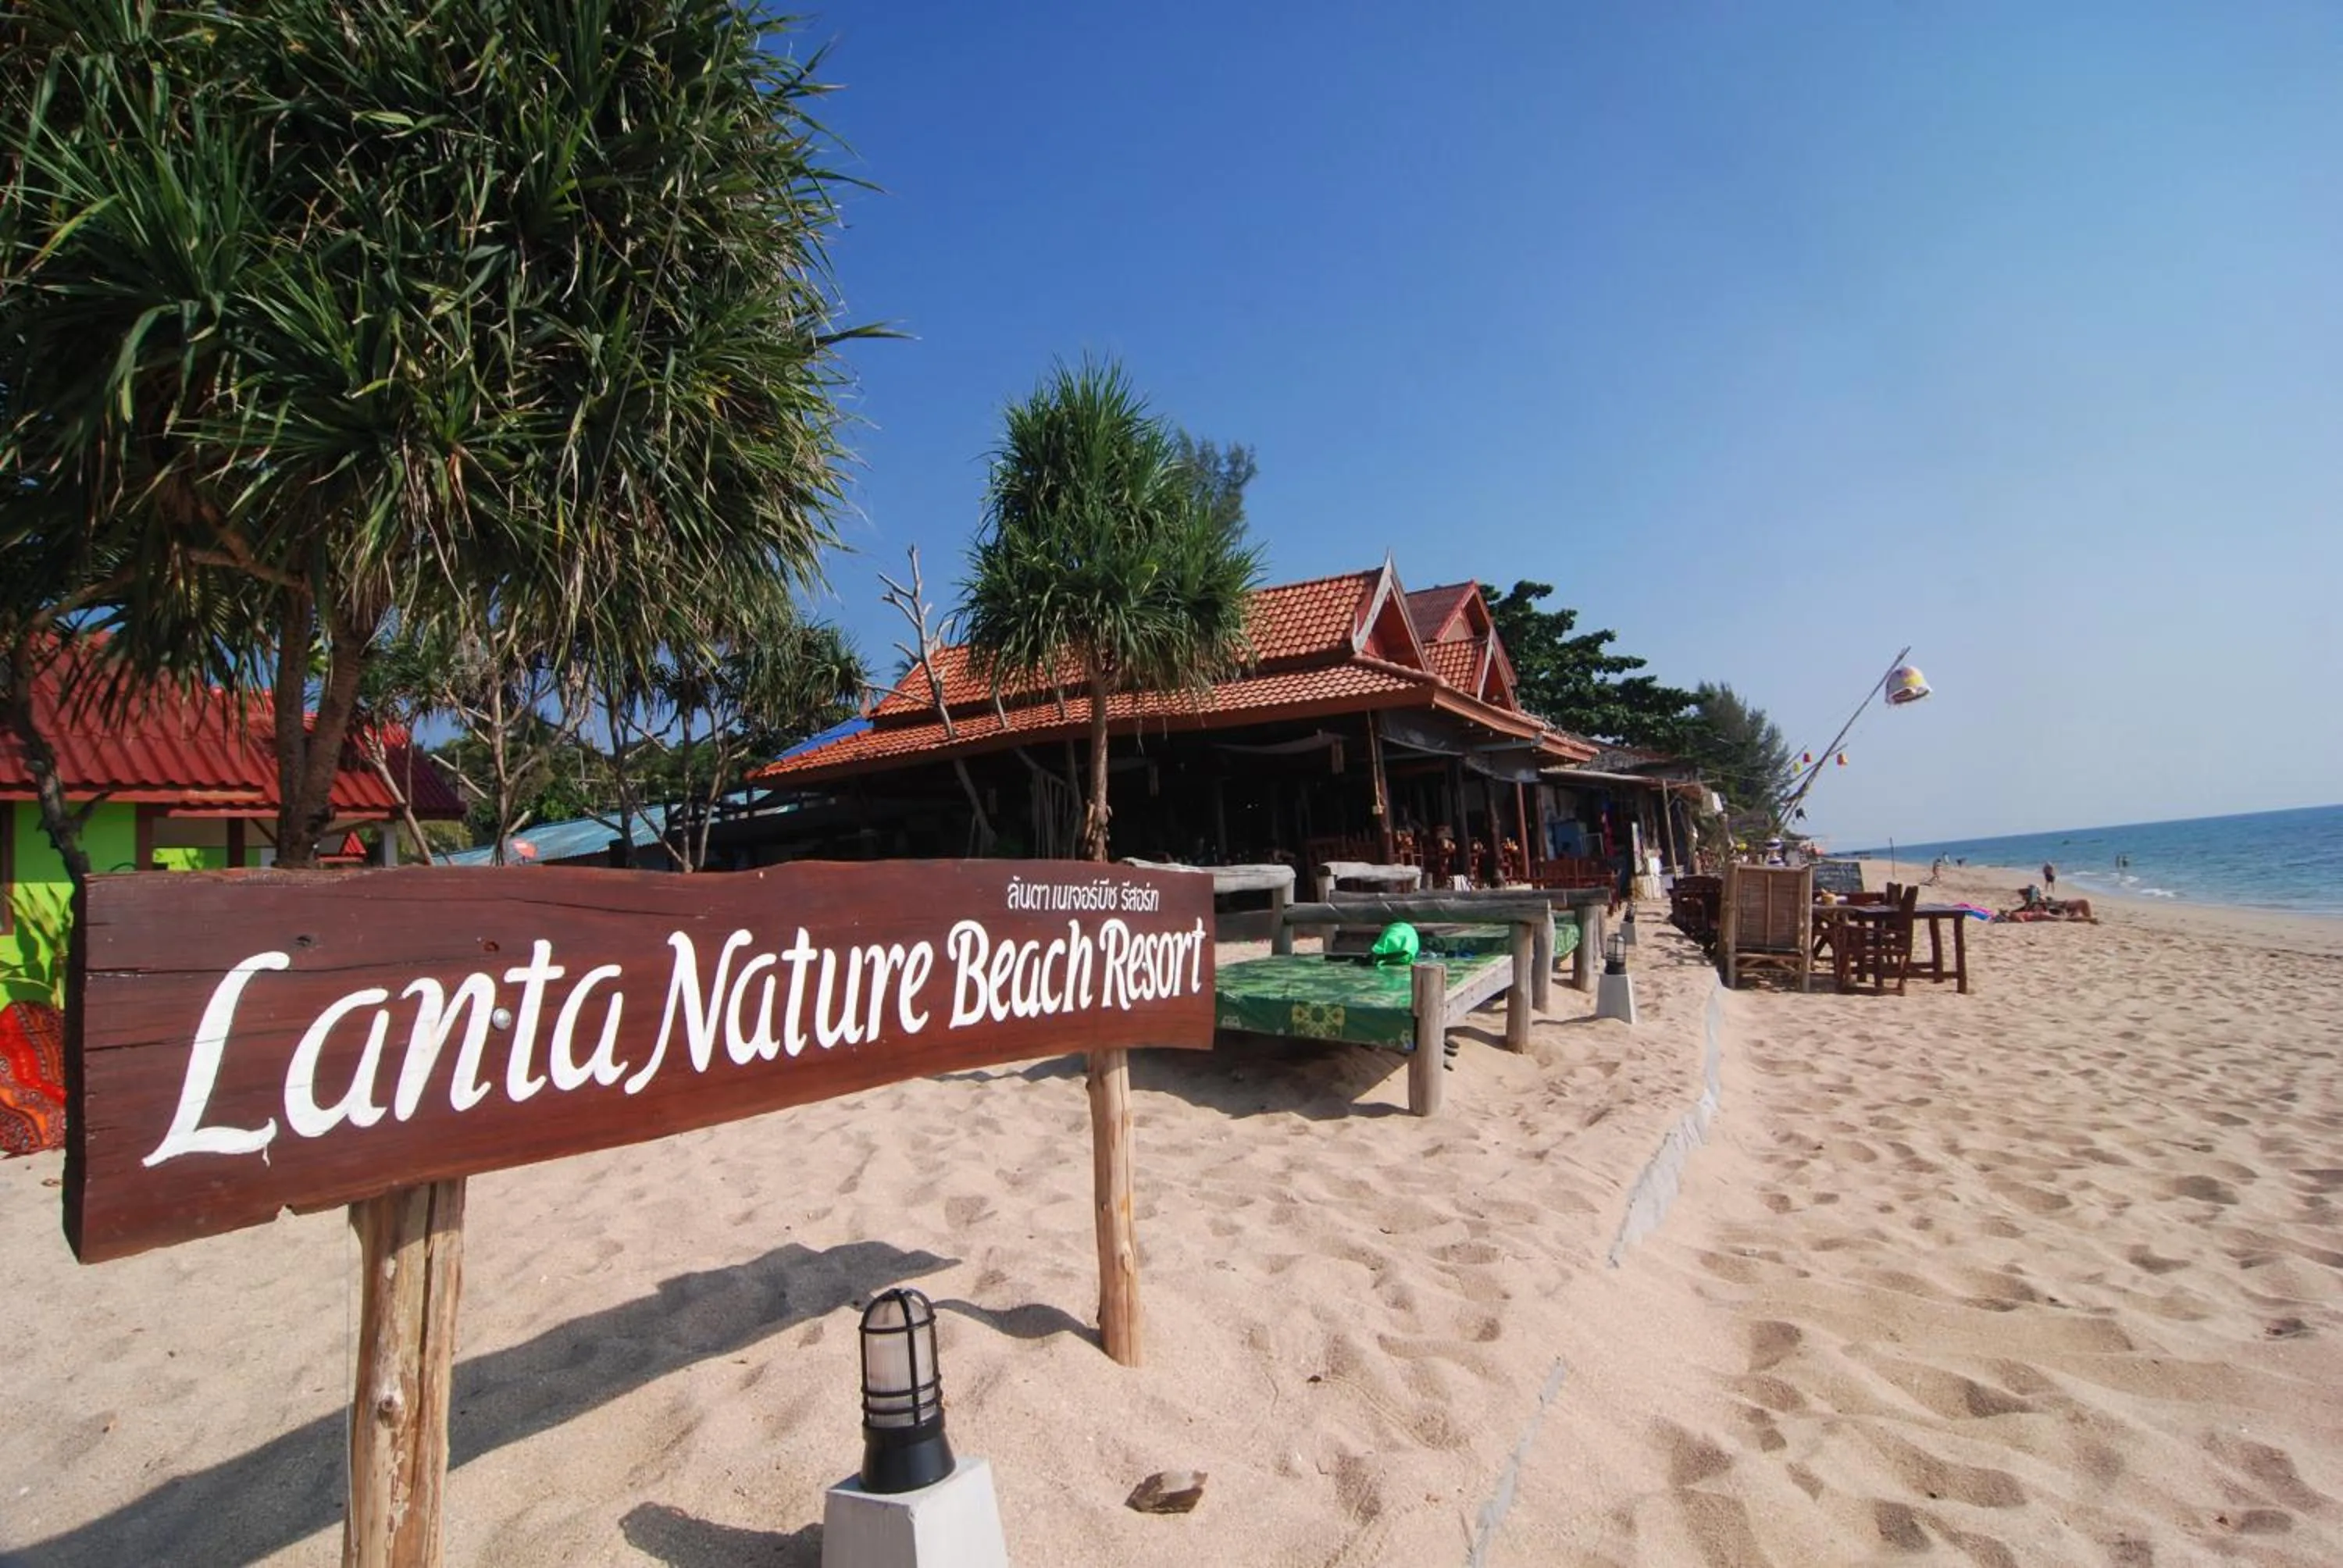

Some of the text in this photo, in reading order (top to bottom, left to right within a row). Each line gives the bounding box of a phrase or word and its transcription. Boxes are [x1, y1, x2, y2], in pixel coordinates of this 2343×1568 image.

[1007, 875, 1050, 911] ลันตา
[141, 916, 1207, 1168] Lanta Nature Beach Resort
